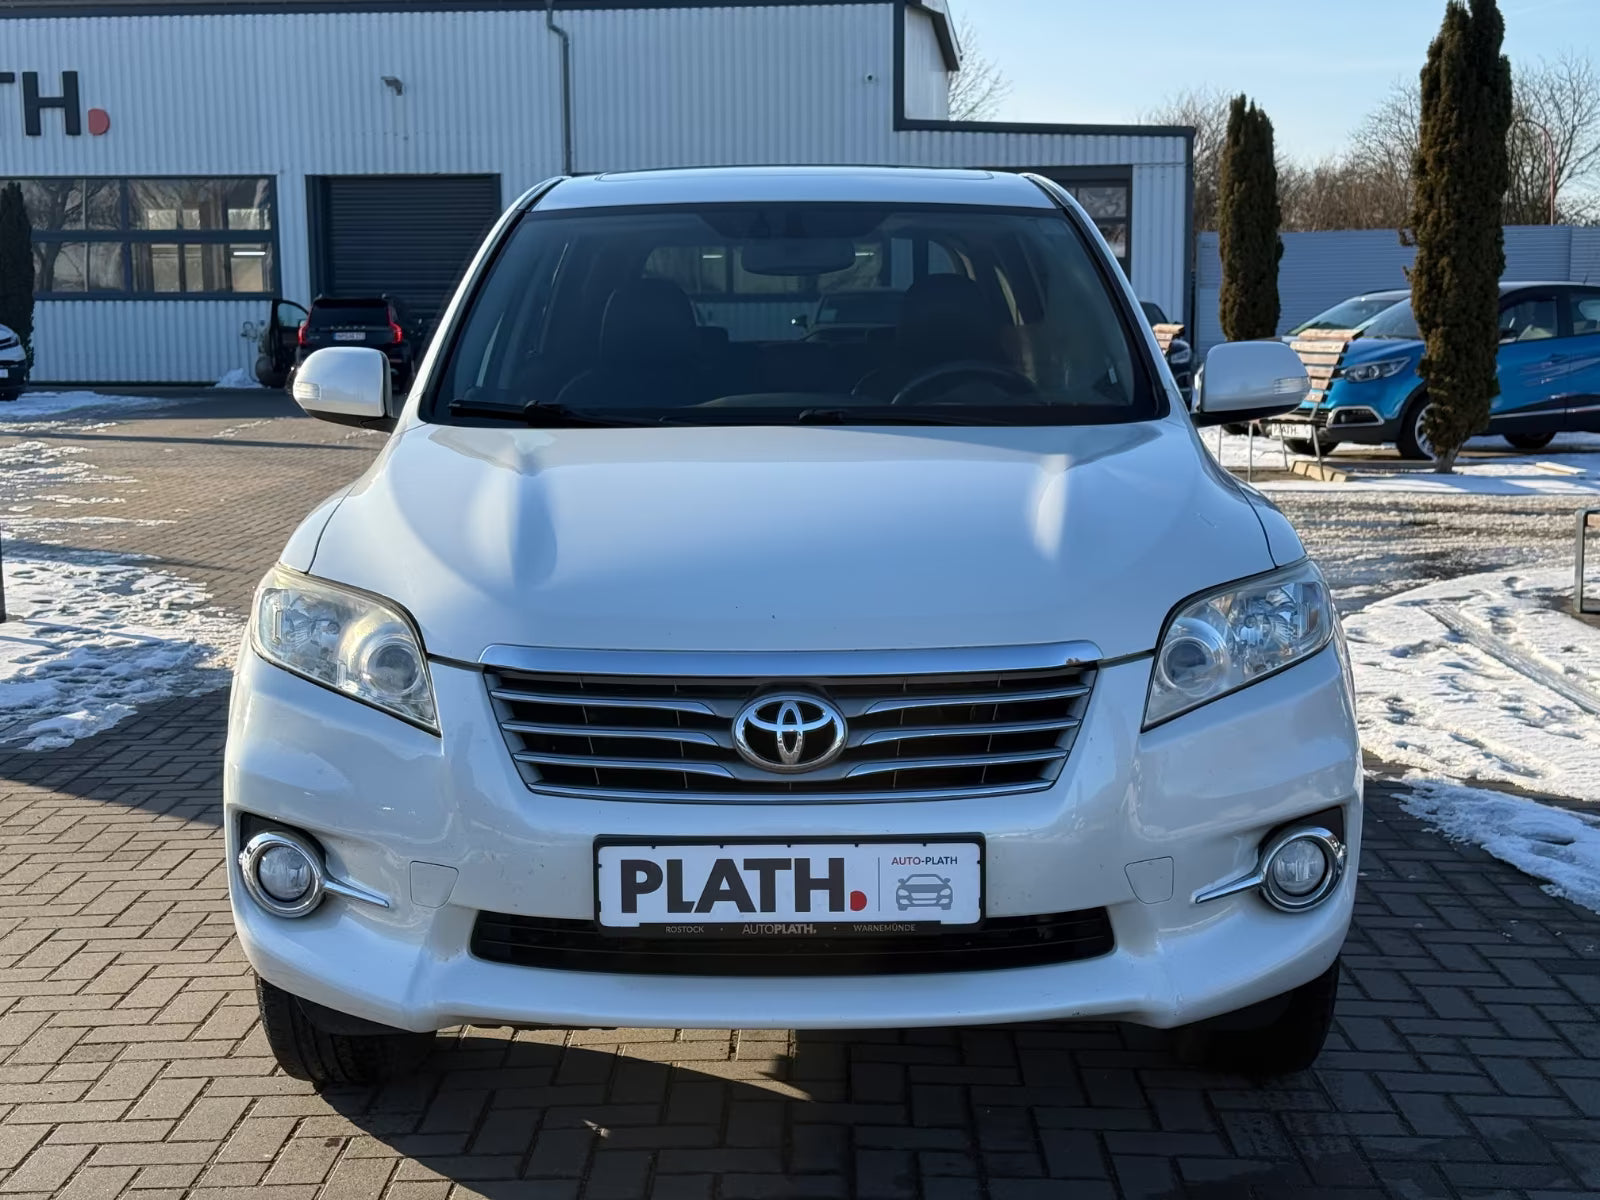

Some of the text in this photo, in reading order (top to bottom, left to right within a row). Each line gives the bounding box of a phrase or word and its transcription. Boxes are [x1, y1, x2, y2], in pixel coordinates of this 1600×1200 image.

[0, 70, 110, 136] H.
[891, 856, 958, 866] AUTO-PLATH
[665, 925, 705, 934] ROSTOCK
[853, 923, 917, 933] WARNEMÜNDE
